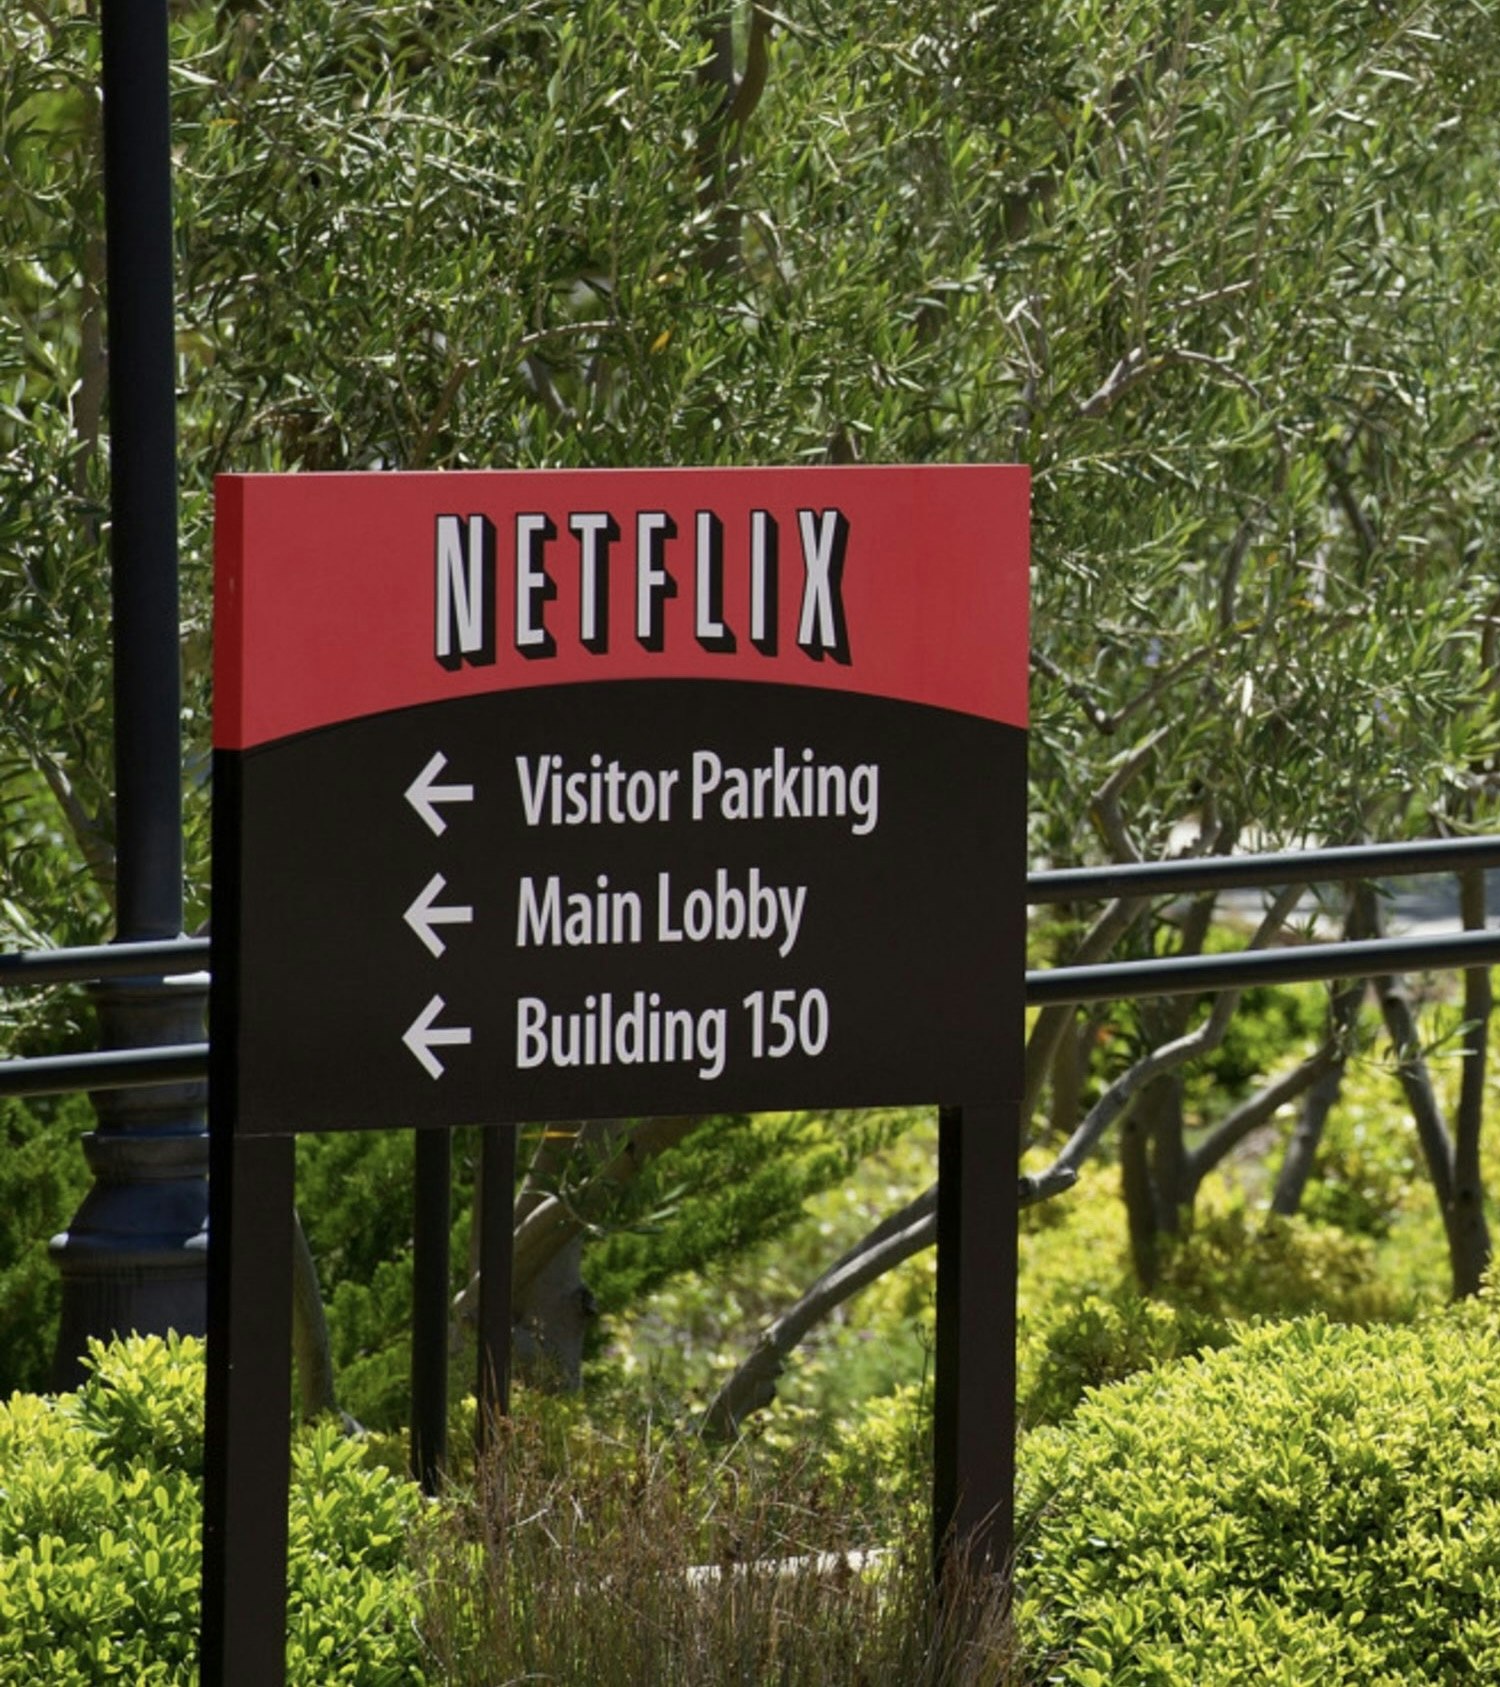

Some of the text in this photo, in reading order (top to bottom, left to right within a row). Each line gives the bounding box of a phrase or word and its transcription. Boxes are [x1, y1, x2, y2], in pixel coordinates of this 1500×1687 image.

[436, 509, 851, 671] NETFLIX
[516, 747, 880, 835] Visitor Parking
[516, 867, 808, 958] Main Lobby
[516, 988, 830, 1080] Building 150
